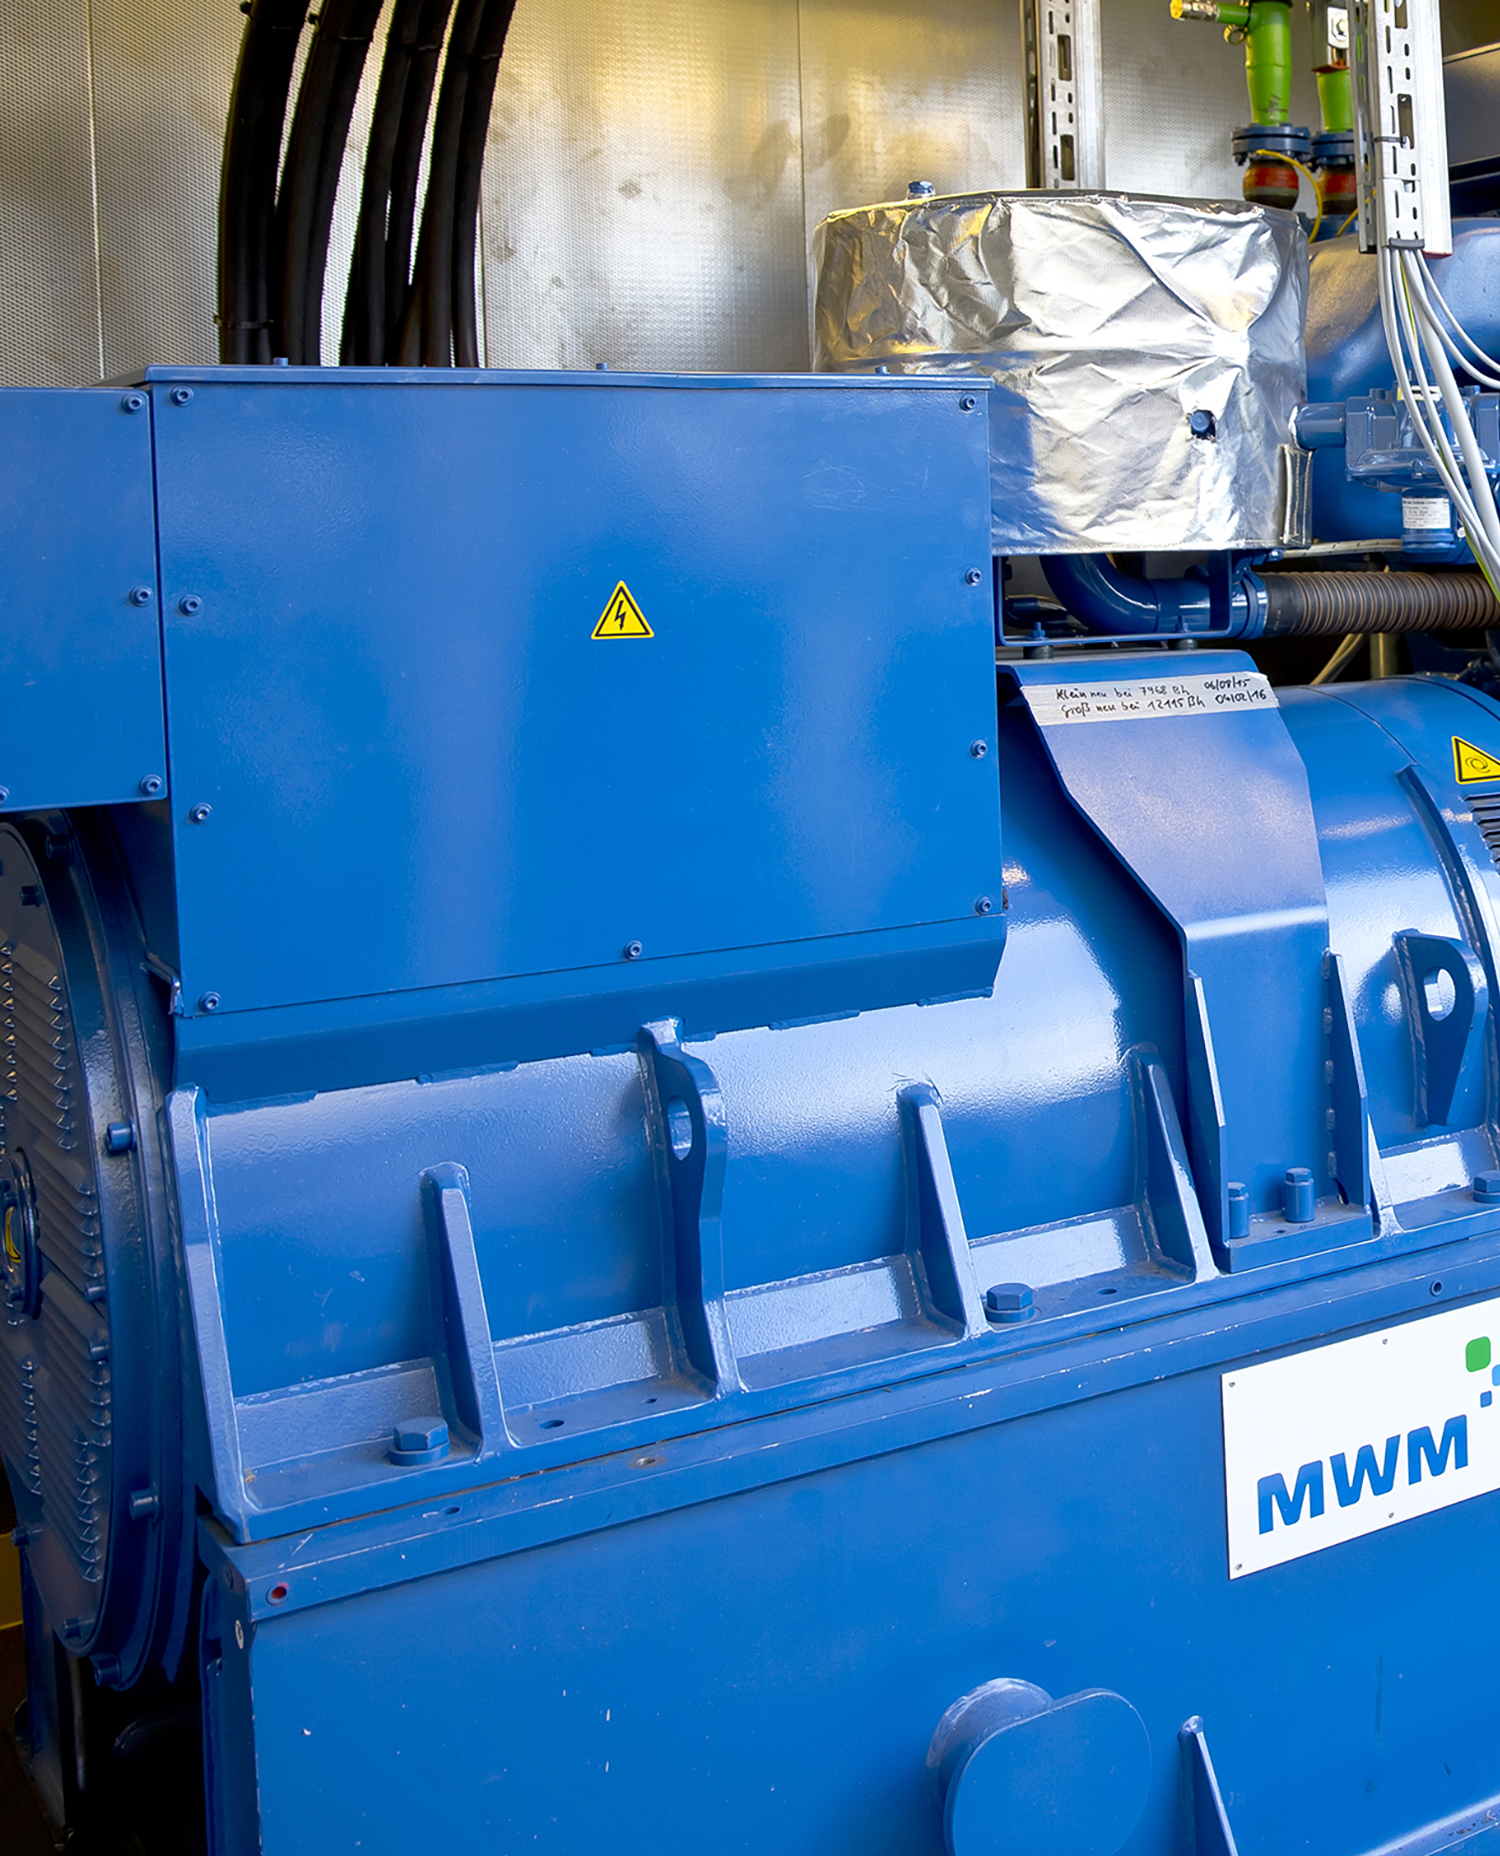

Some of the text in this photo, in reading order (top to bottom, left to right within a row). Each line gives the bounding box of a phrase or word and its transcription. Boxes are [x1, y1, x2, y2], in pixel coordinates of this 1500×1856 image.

[1056, 687, 1087, 700] Klein
[1090, 691, 1107, 699] neu
[1113, 687, 1132, 698] bei
[1096, 703, 1116, 712] neu
[1121, 701, 1140, 711] bei
[1147, 697, 1185, 711] 12115
[1188, 695, 1206, 708] Bh
[1257, 1414, 1469, 1535] MWM
